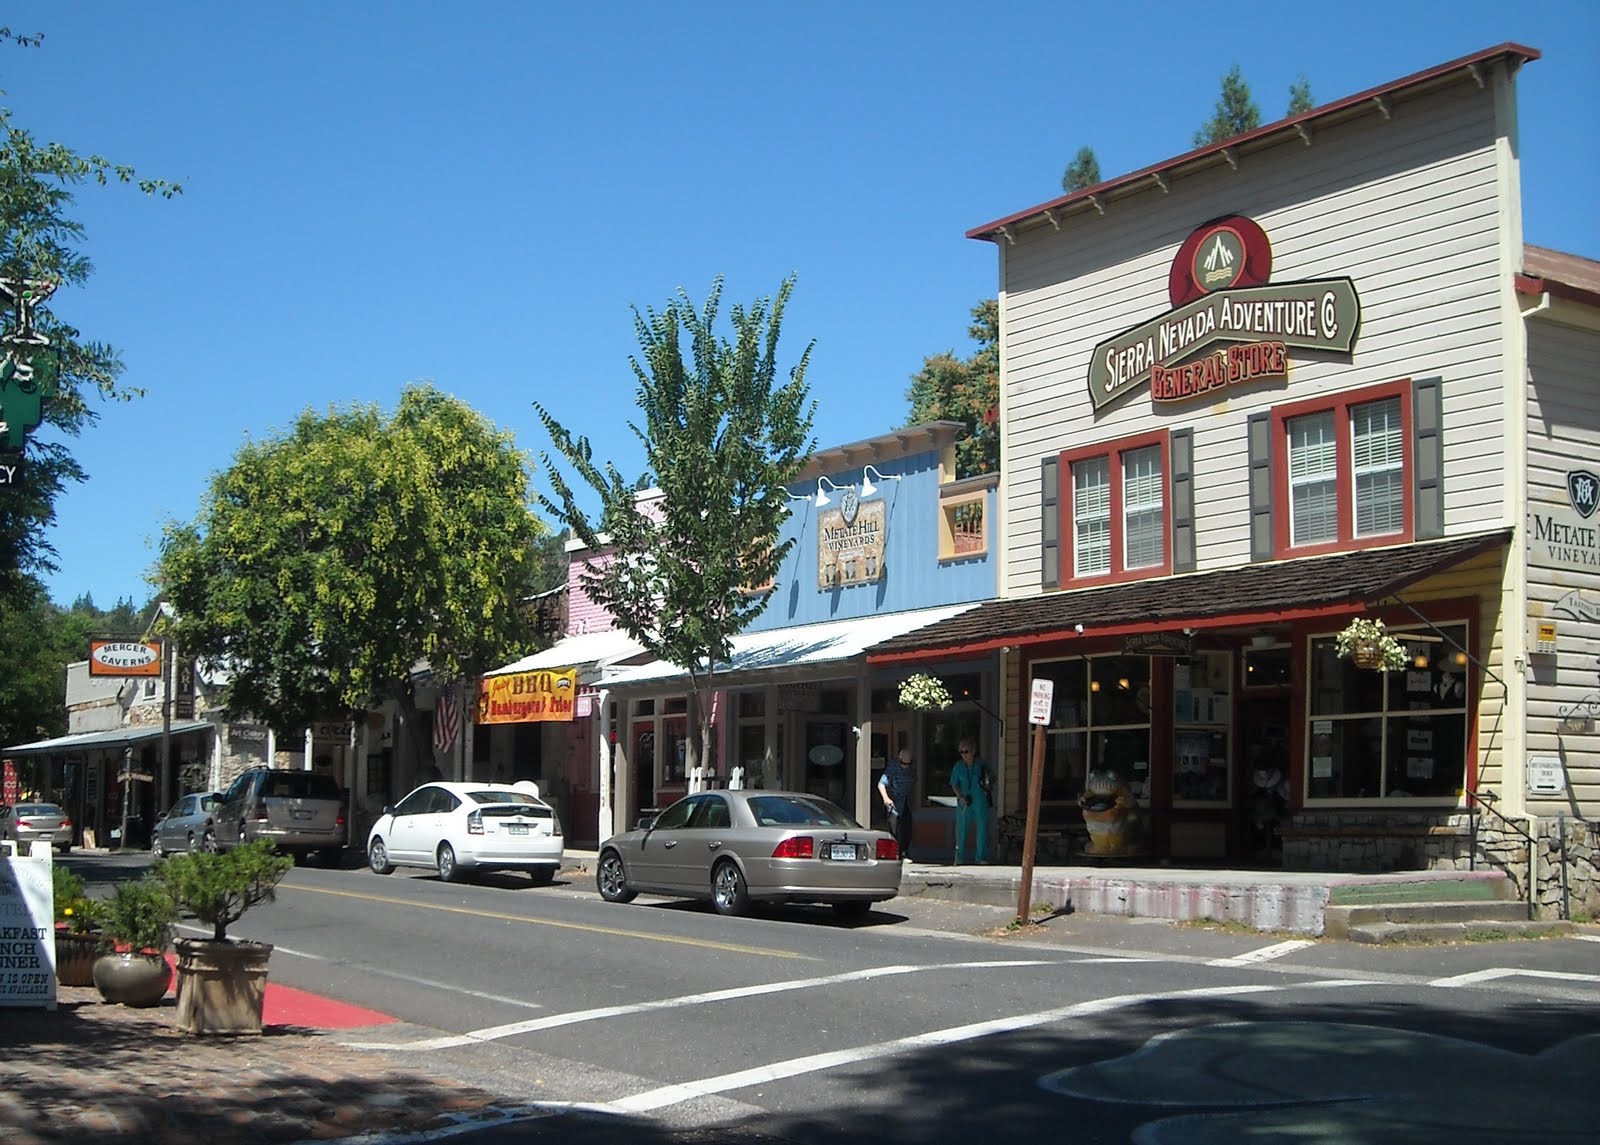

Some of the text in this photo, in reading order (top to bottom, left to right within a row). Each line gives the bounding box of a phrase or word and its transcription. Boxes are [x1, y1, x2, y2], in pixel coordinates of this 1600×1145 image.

[1105, 336, 1155, 392] SIERRA
[1159, 306, 1216, 361] NEVADA
[1219, 297, 1317, 337] ADVENTURE
[1152, 343, 1285, 400] GENERAL STORE
[825, 520, 879, 541] METATE HILL
[1534, 514, 1596, 548] METATE
[828, 534, 875, 551] VINEYARDS
[1548, 545, 1600, 566] VINEYA
[103, 644, 147, 655] MERCER
[101, 655, 151, 667] CAVERNS
[512, 673, 552, 694] BBQ
[21, 973, 48, 984] OPEN
